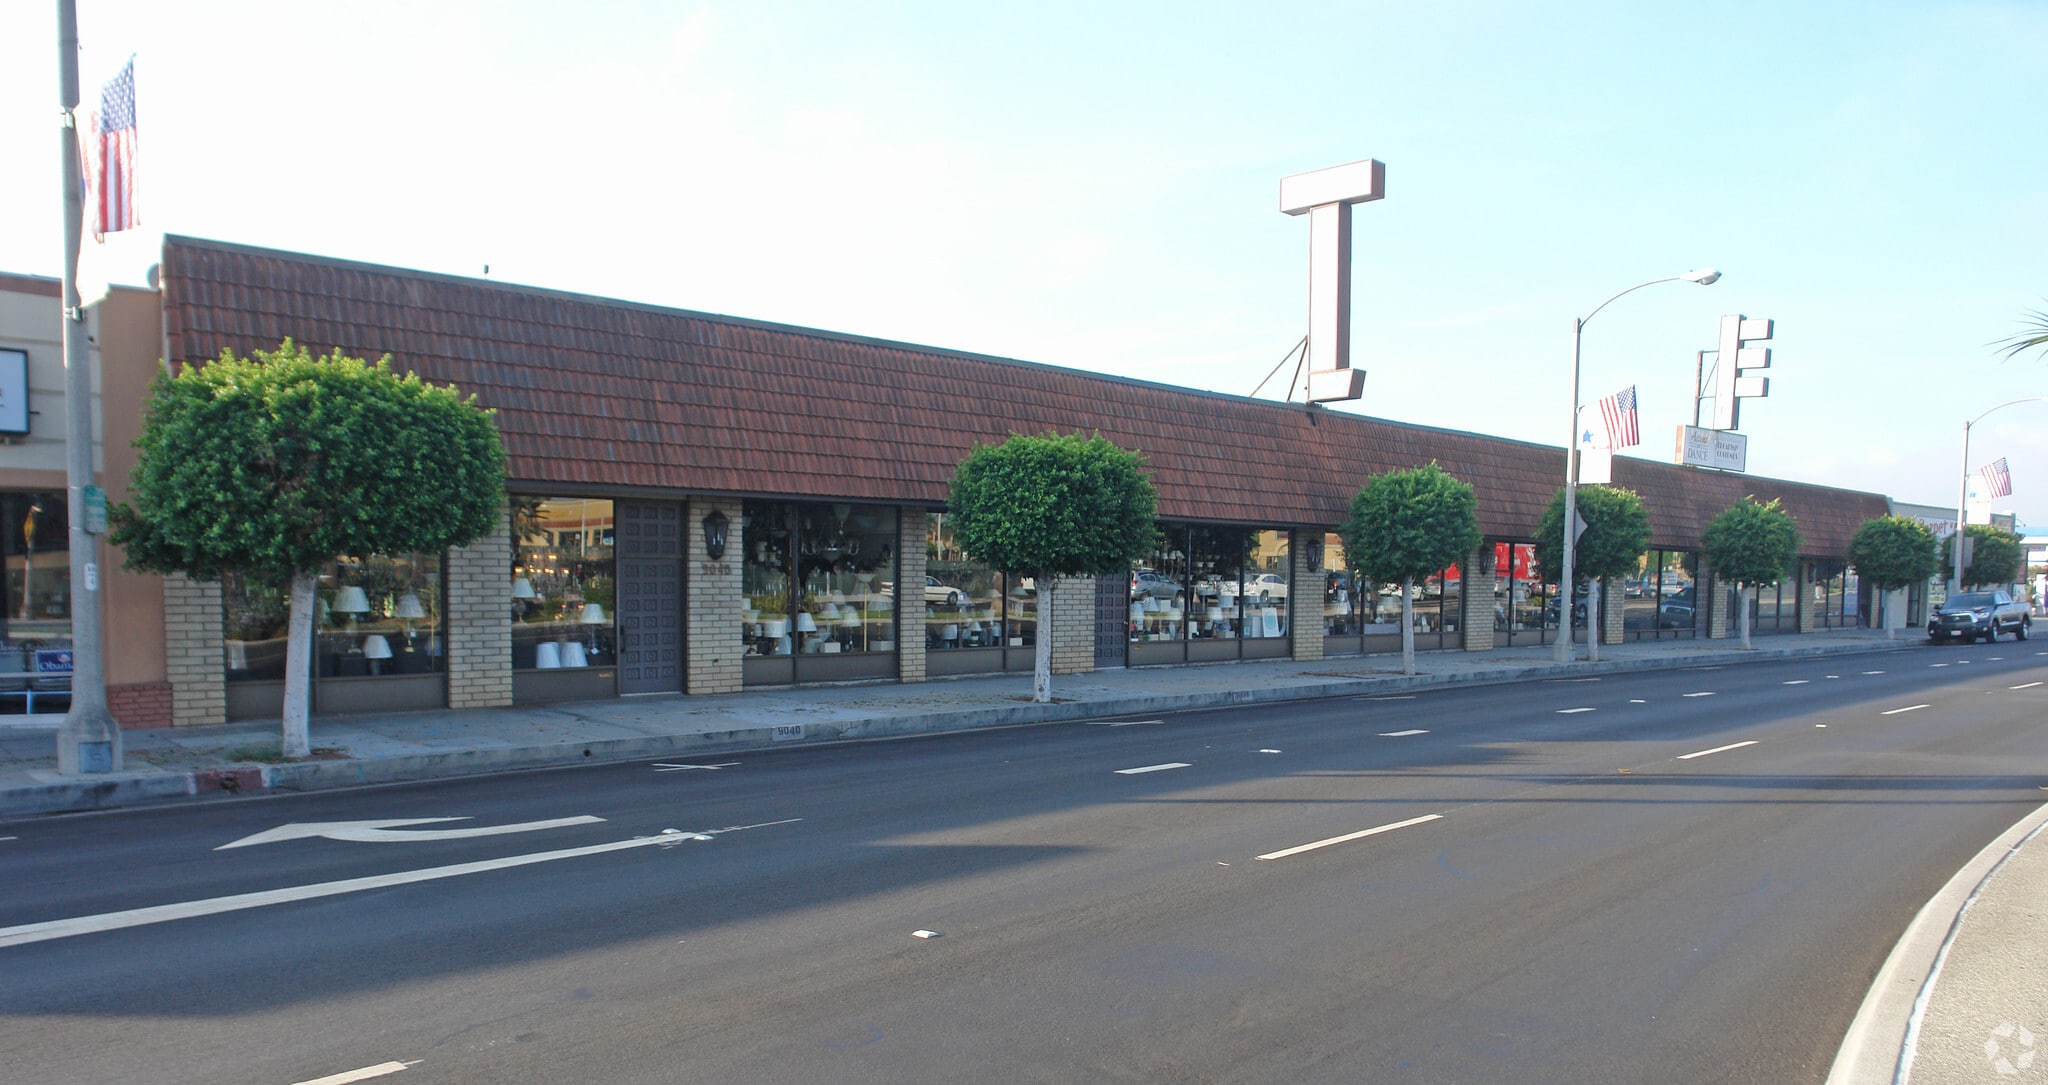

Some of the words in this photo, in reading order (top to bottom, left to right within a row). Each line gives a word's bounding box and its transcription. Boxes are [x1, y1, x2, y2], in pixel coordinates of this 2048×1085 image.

[1688, 447, 1709, 461] DANCE
[702, 564, 732, 576] 9040
[778, 725, 801, 736] 9040
